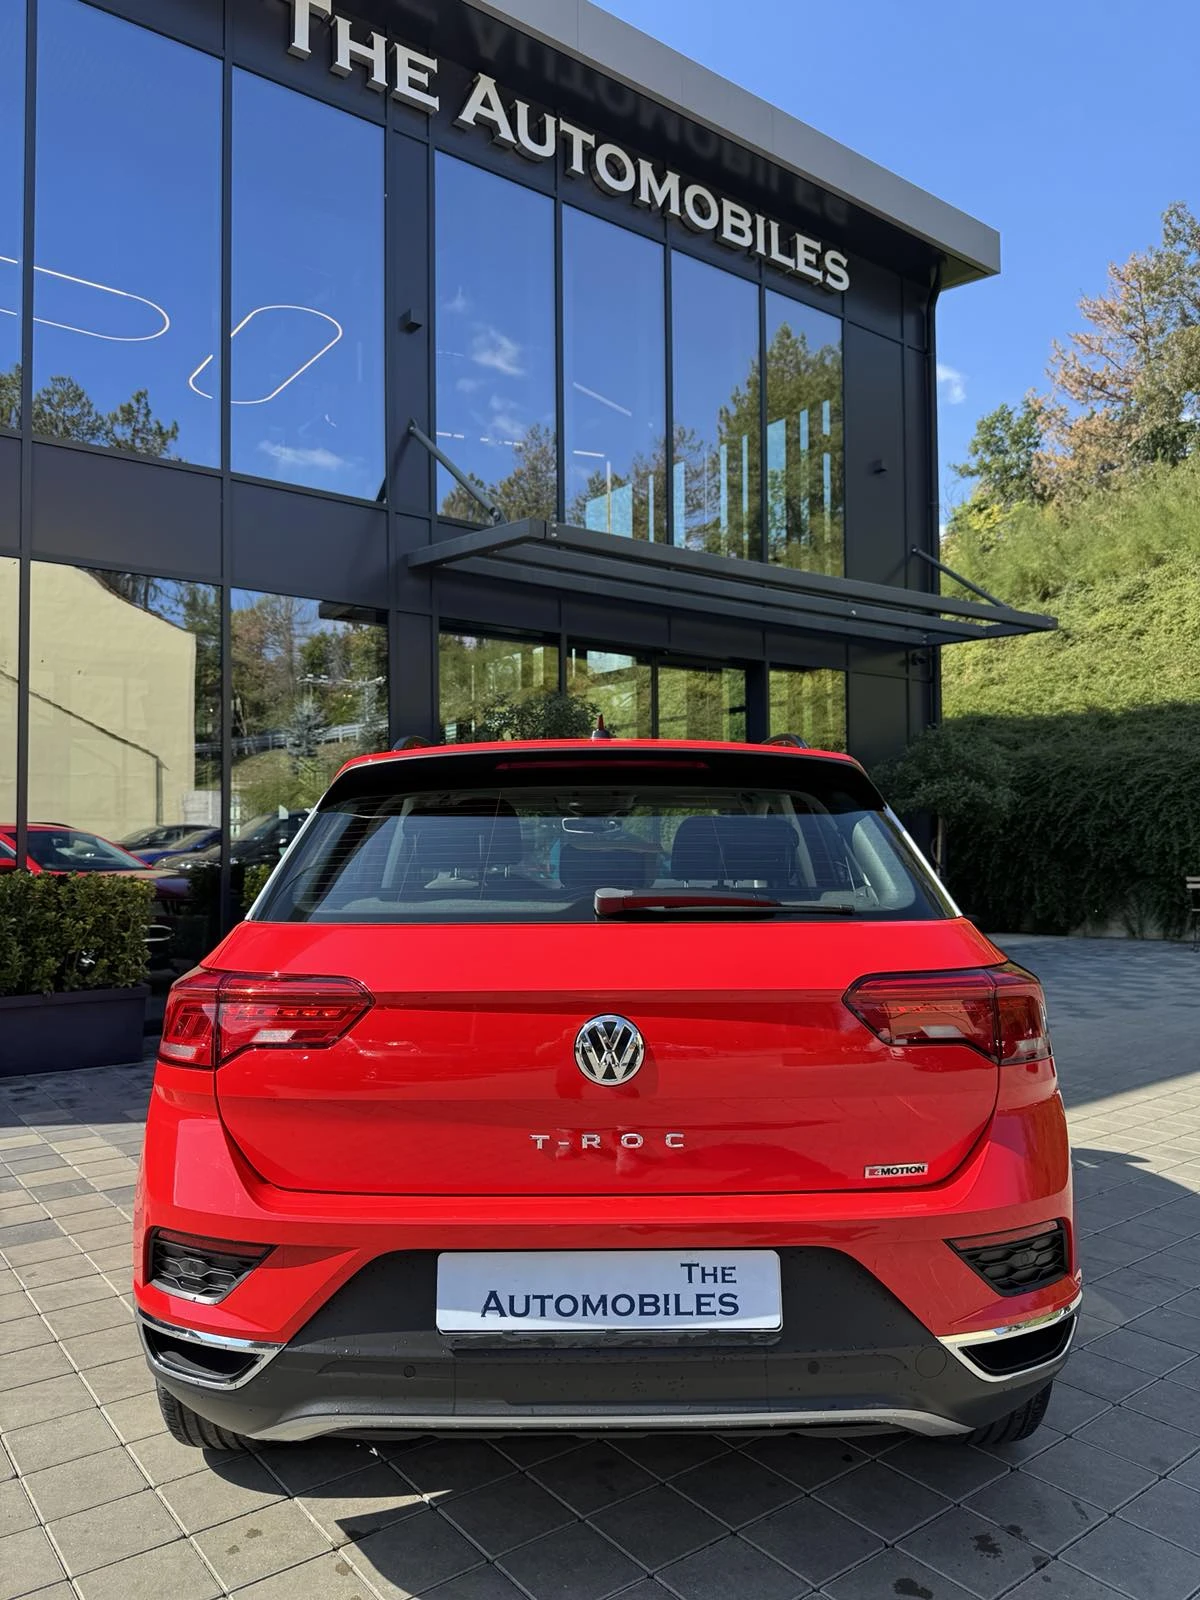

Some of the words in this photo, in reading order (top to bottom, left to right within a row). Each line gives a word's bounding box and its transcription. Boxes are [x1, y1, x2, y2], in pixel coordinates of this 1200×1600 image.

[287, 0, 440, 114] THE
[456, 72, 851, 293] AUTOMOBILES
[576, 1016, 644, 1085] VW
[530, 1133, 684, 1150] T-ROC
[680, 1263, 737, 1284] THE
[481, 1291, 740, 1318] AUTOMOBILES
